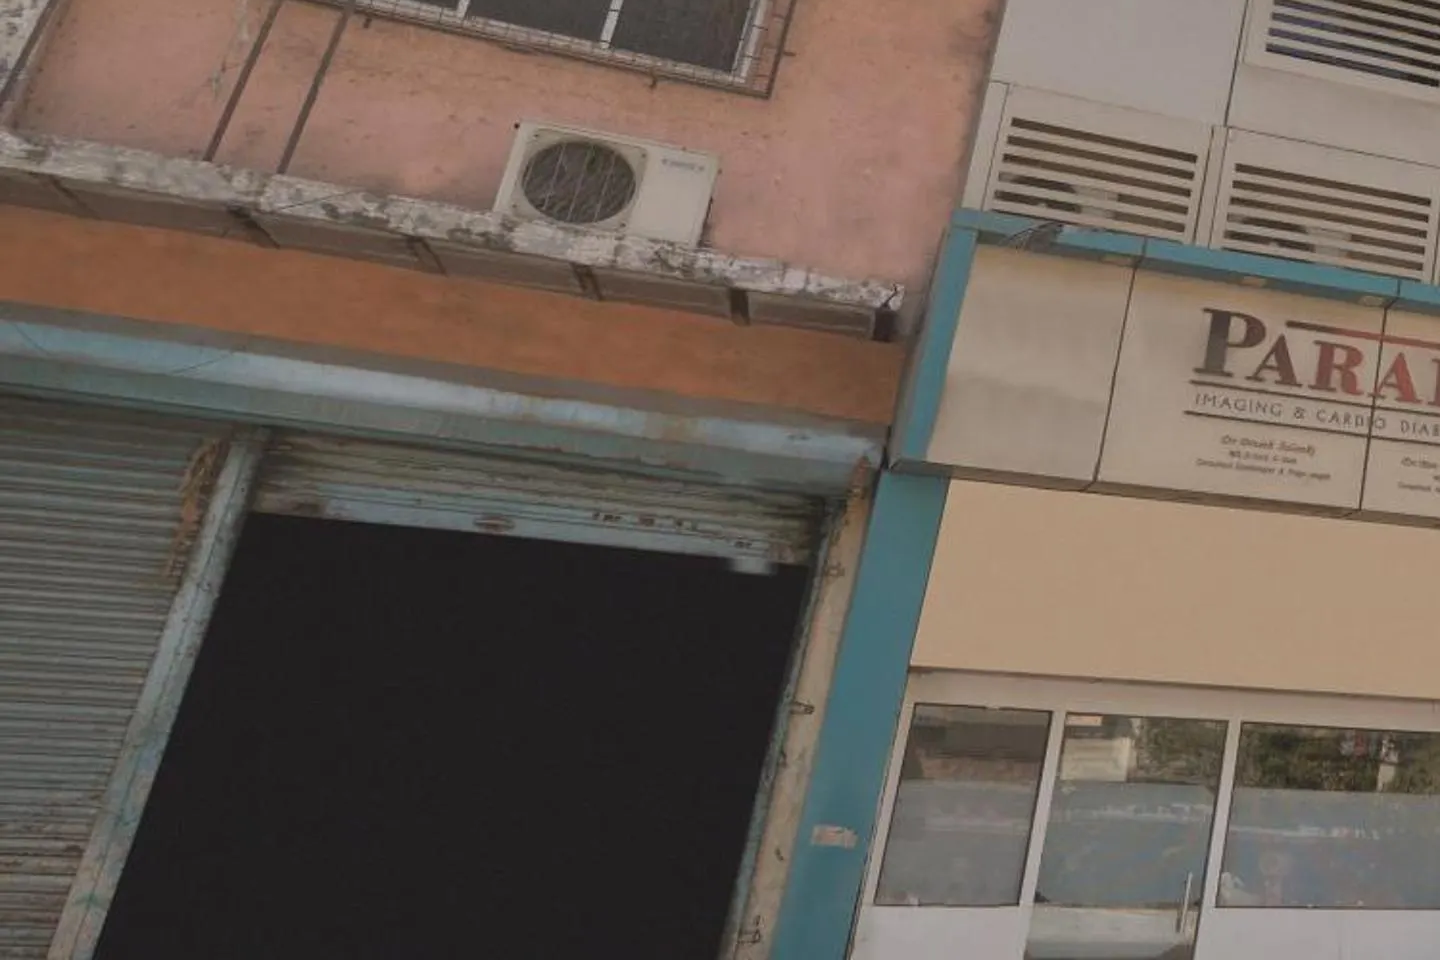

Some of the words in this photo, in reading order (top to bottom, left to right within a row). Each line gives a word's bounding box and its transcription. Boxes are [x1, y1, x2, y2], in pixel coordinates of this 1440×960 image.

[1195, 393, 1282, 417] IMAGING
[1293, 406, 1305, 420] &
[1316, 408, 1386, 429] CARDIO
